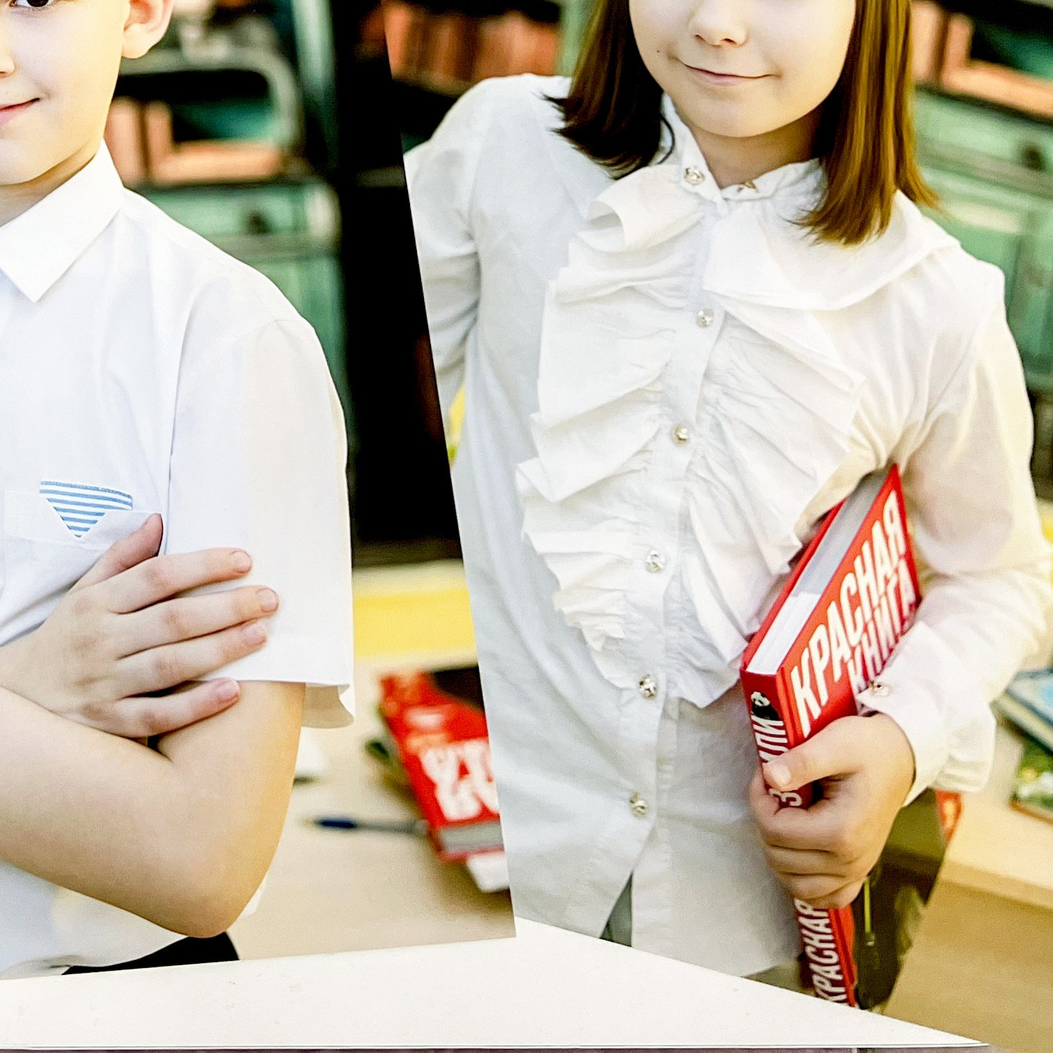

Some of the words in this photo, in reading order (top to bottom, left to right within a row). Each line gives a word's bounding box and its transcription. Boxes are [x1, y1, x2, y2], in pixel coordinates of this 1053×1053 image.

[791, 489, 907, 739] КРАСНАЯ
[848, 559, 917, 696] КНИГА
[750, 712, 803, 808] ЗЛИ
